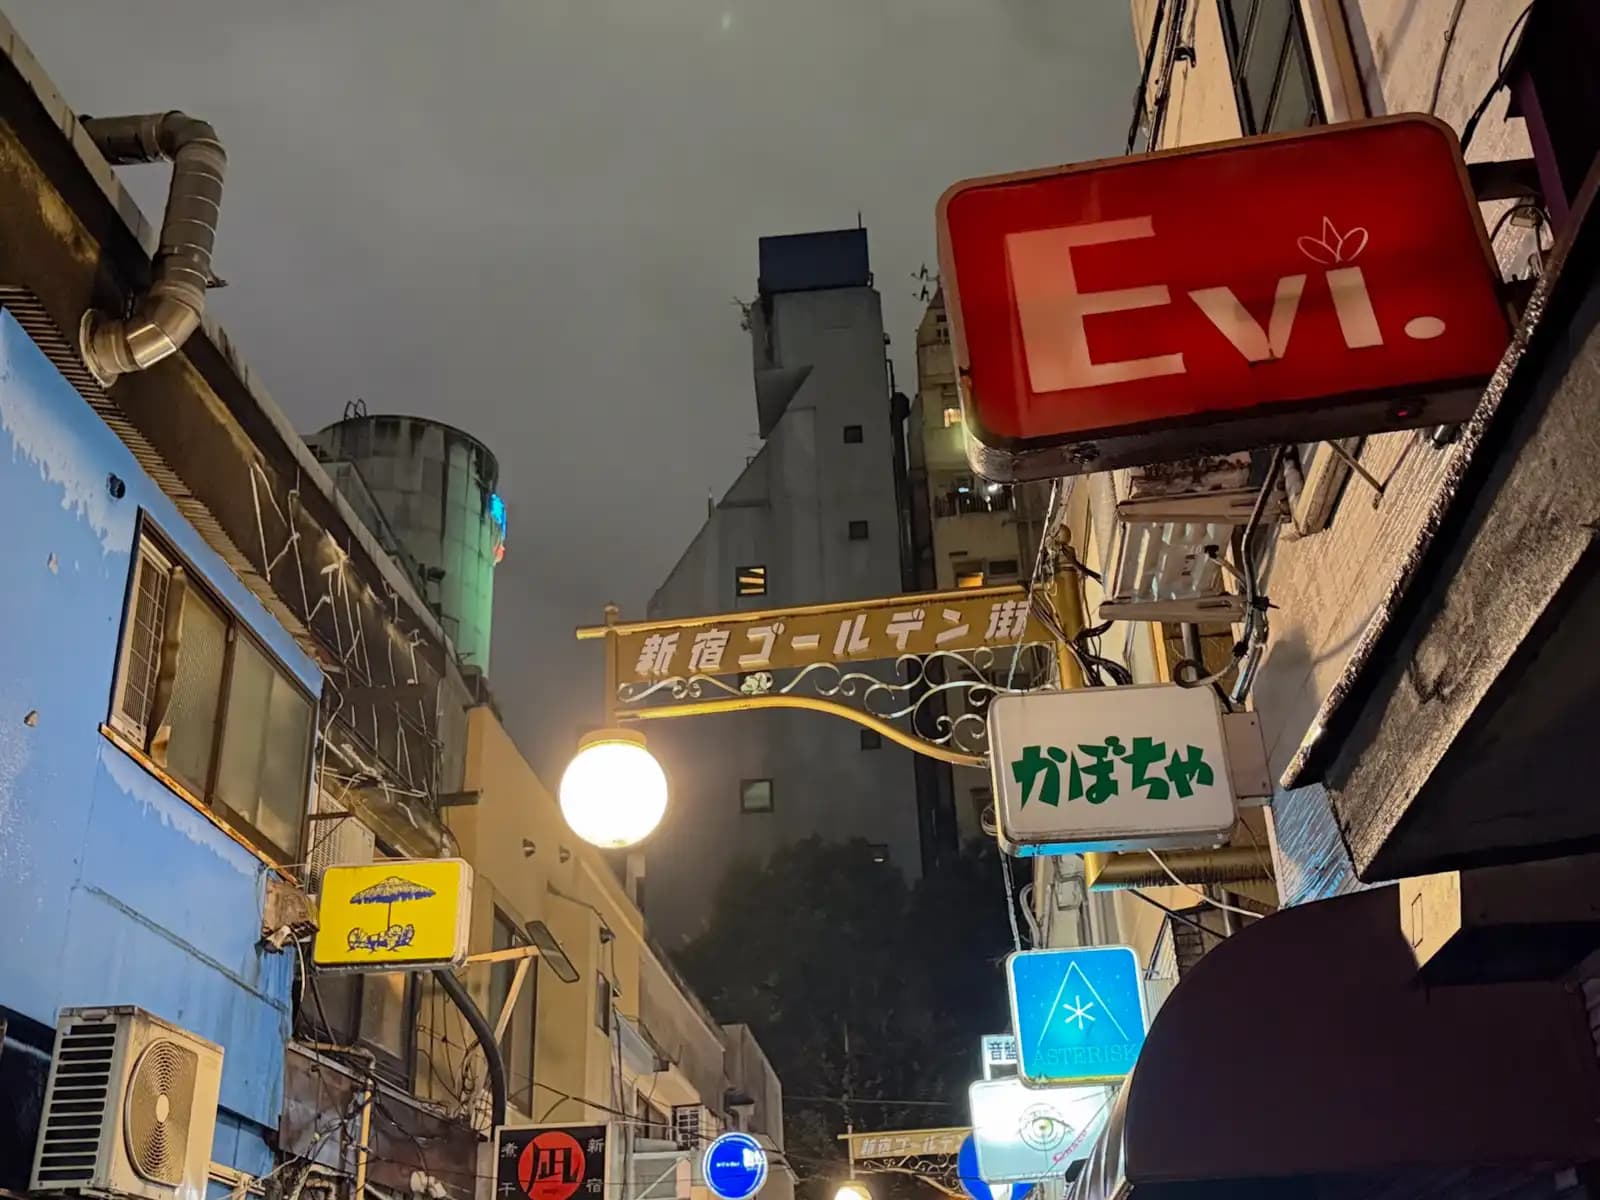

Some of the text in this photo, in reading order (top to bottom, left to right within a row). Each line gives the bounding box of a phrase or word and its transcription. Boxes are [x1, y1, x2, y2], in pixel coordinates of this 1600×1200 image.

[1006, 214, 1446, 394] Evi.
[633, 600, 1029, 676] 新宿ゴールデン街
[1011, 736, 1214, 810] かぼちゃ
[1032, 1042, 1139, 1066] ASTERISK
[526, 1141, 582, 1193] 凪
